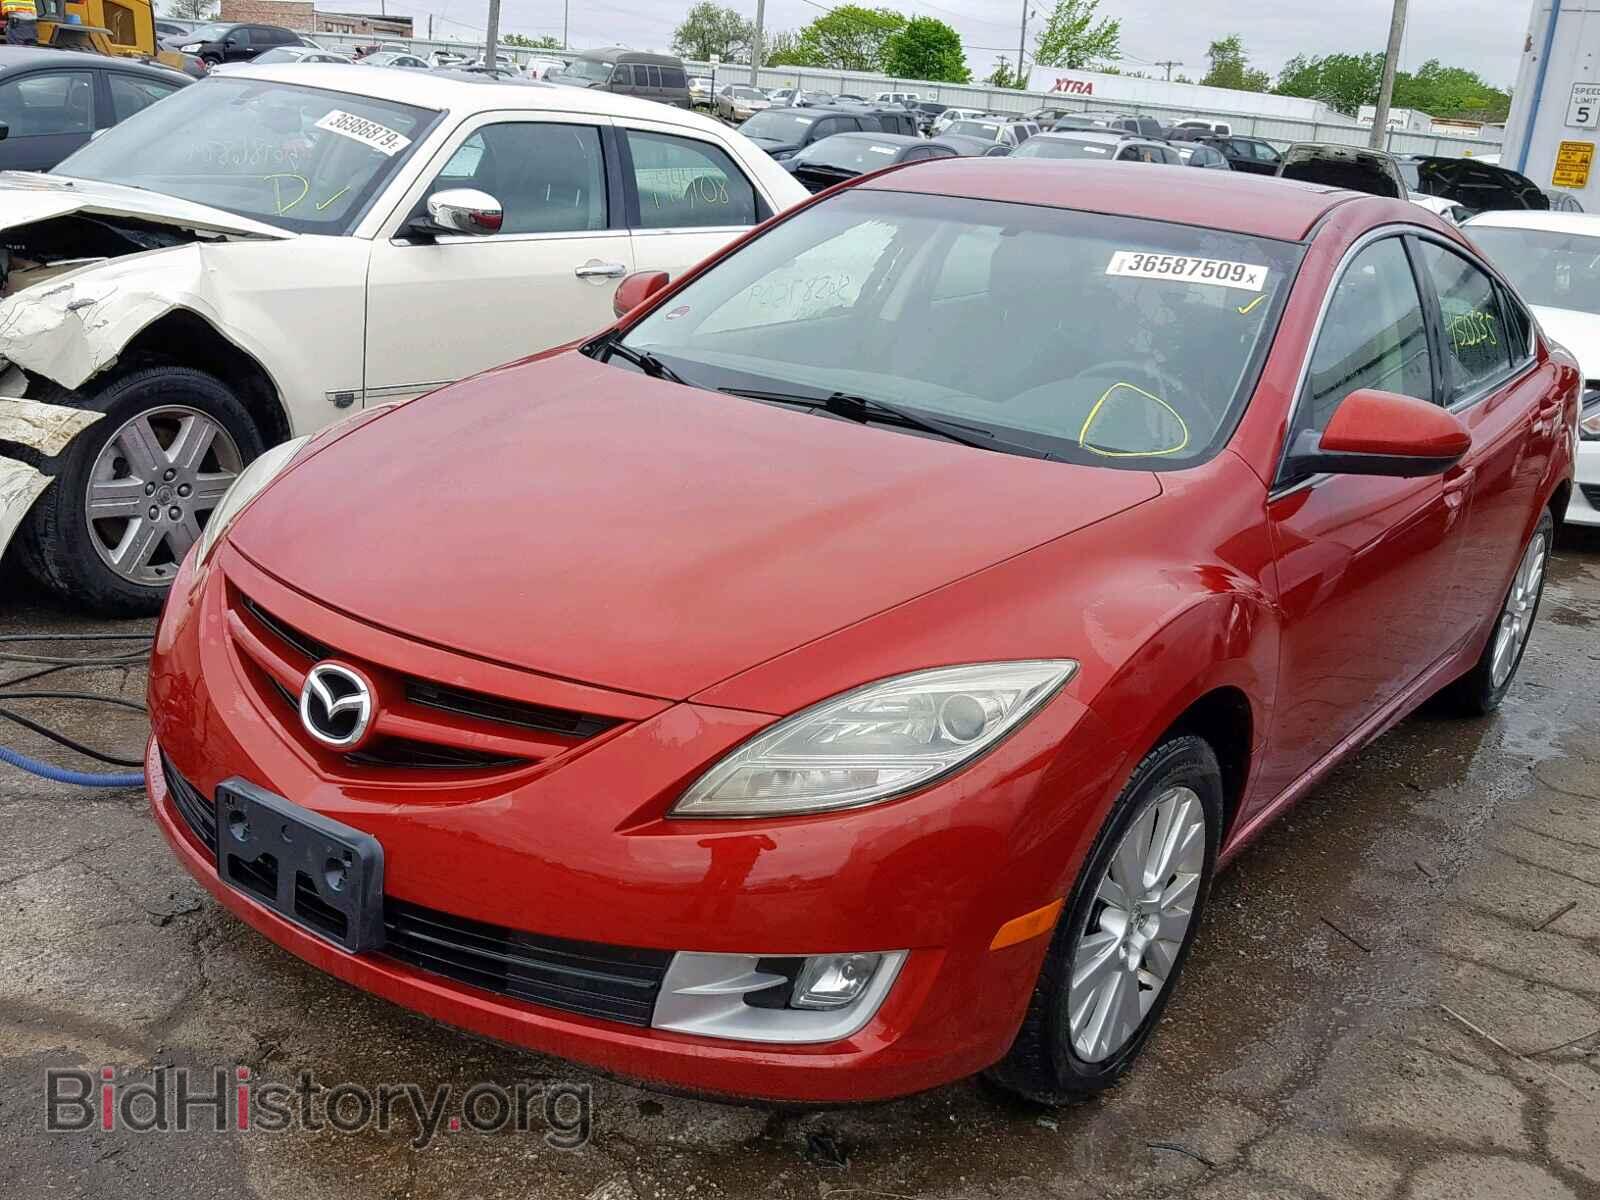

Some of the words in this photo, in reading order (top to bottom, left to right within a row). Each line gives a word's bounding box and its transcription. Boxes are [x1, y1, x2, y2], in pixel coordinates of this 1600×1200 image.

[1049, 79, 1093, 95] XTRA
[1575, 96, 1597, 104] LIMIT
[1576, 107, 1591, 123] 5
